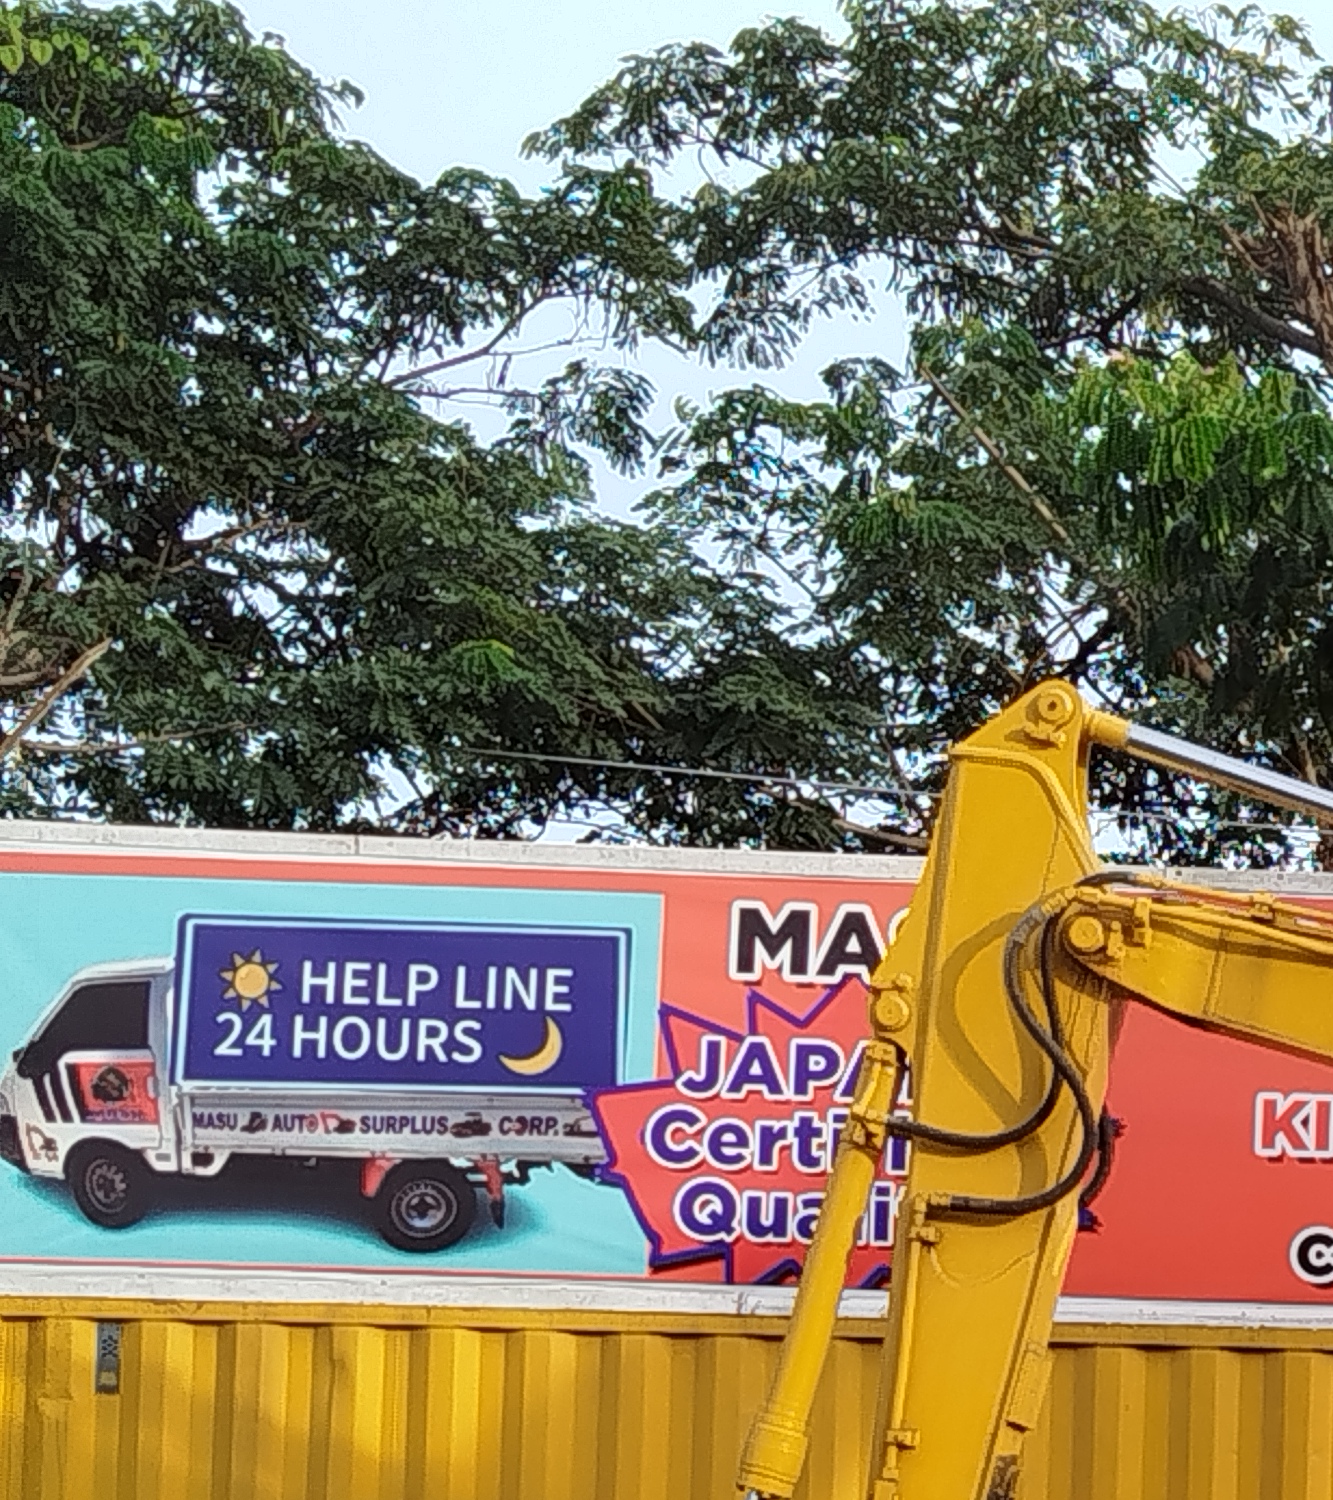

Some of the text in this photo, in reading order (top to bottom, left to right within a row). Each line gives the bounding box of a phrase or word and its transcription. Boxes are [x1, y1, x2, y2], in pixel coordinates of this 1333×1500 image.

[734, 903, 908, 977] MA
[302, 960, 574, 1012] HELP LINE
[213, 1014, 483, 1064] 24 HOURS
[682, 1038, 914, 1101] JAP
[191, 1111, 239, 1133] MASU
[270, 1113, 319, 1134] AUTO
[358, 1113, 450, 1135] SURPLUS
